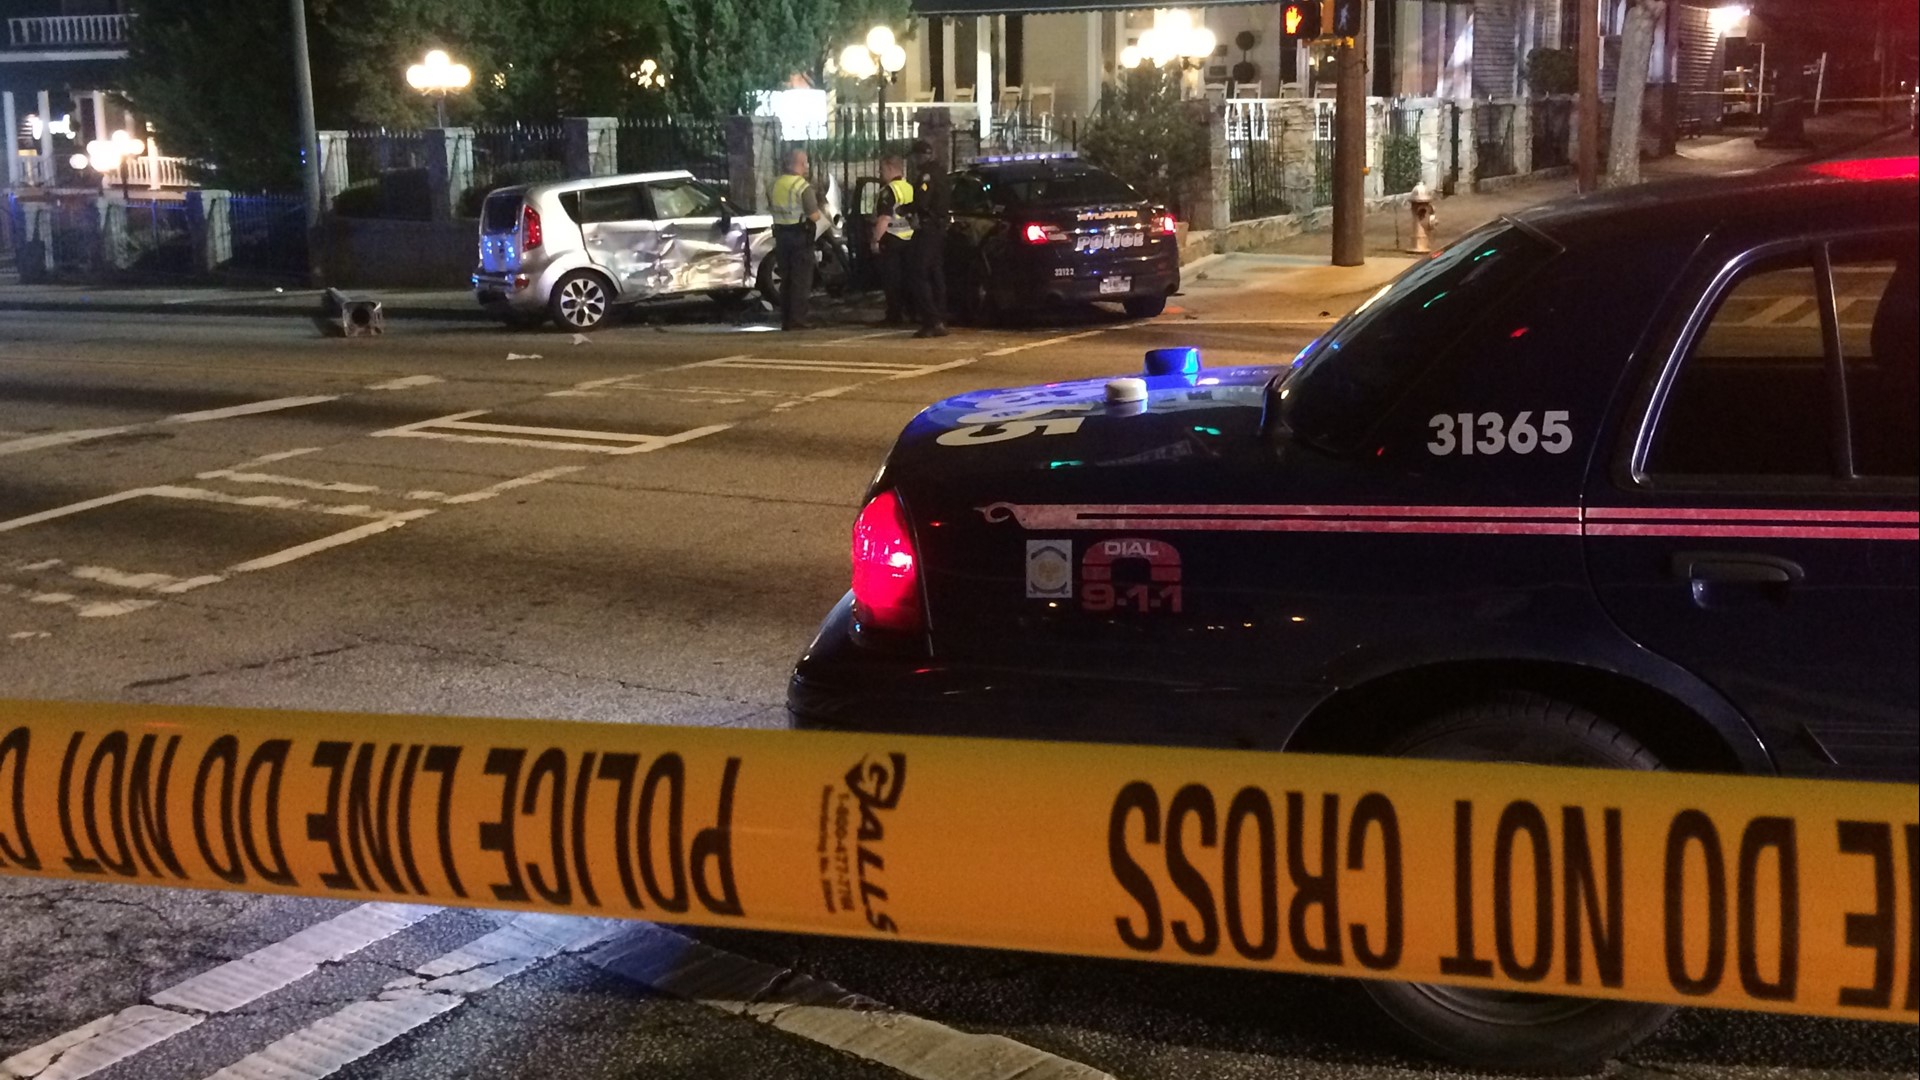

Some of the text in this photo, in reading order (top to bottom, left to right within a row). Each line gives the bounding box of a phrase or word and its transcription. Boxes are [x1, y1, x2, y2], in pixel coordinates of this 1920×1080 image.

[1074, 231, 1144, 251] POLICE
[1427, 410, 1573, 456] 31365
[1081, 583, 1182, 612] 9-1-1
[1104, 541, 1159, 556] DIAL
[58, 730, 190, 880] NOT
[192, 734, 300, 887] DO
[306, 741, 469, 897] LINE
[479, 747, 745, 916] POLICE
[845, 752, 907, 933] GALLS
[1108, 780, 1919, 1011] E DO NOT CROSS
